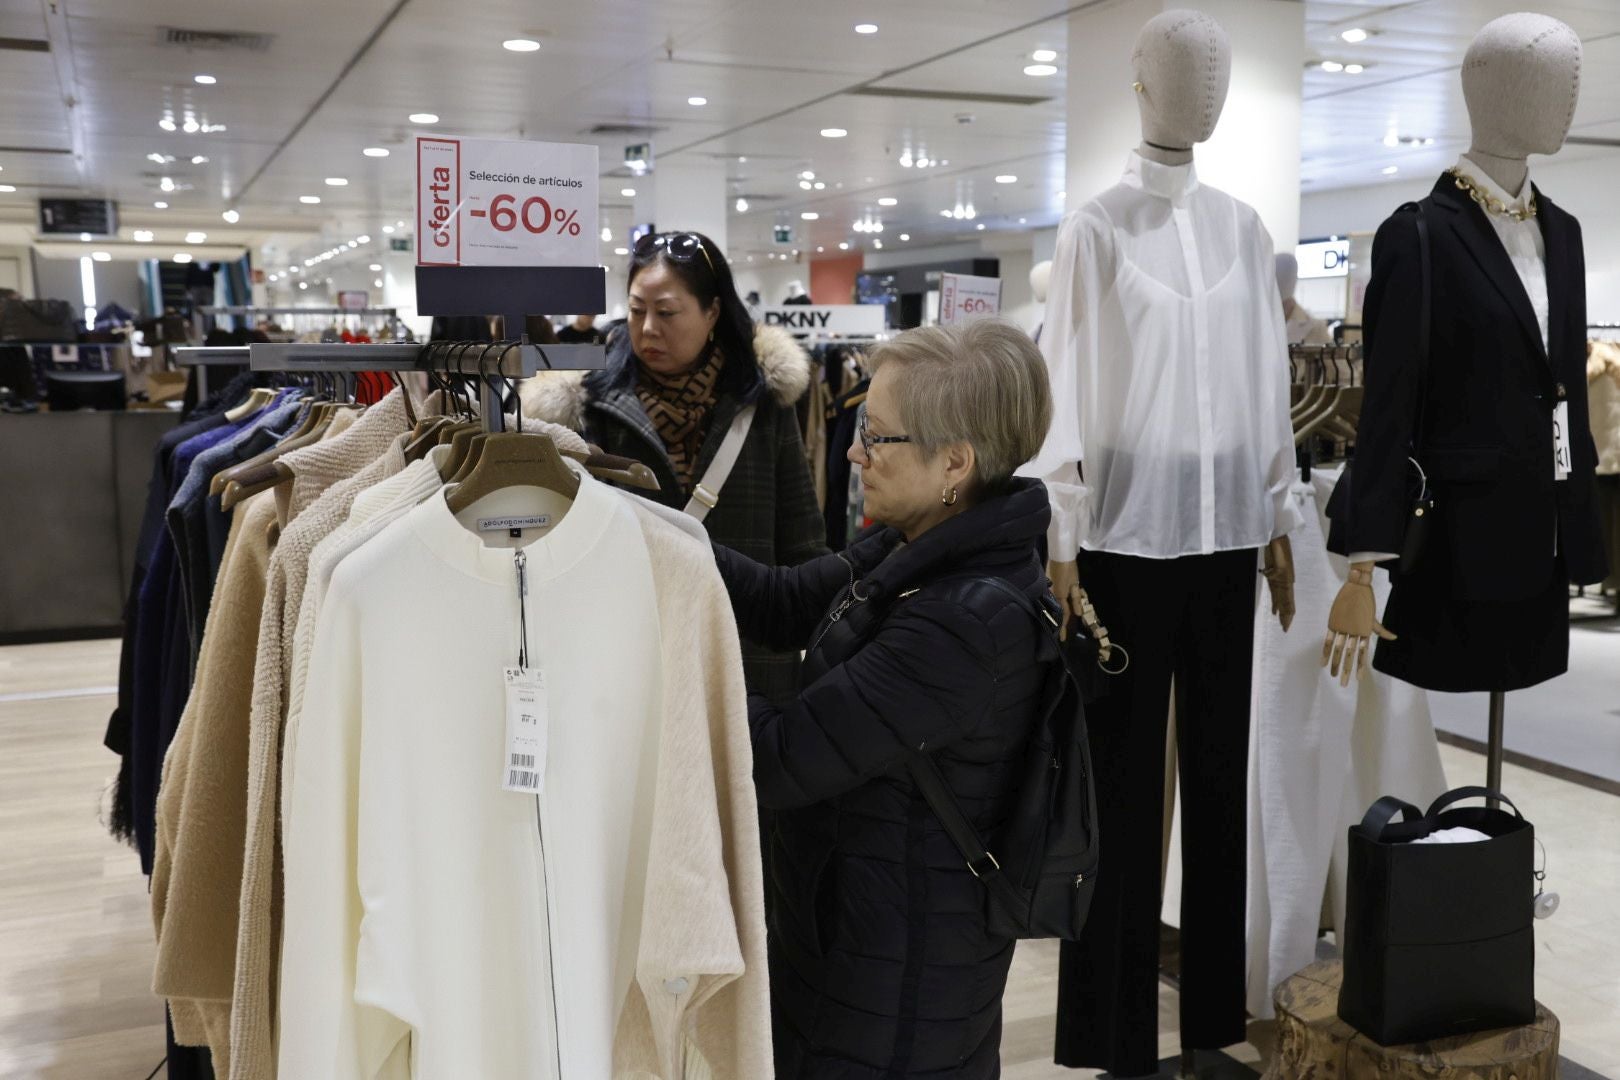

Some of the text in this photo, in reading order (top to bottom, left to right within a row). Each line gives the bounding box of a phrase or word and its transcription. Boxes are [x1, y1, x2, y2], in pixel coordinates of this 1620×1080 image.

[469, 170, 583, 188] Selección de artículos
[428, 166, 451, 248] oferta
[470, 193, 581, 237] -60%
[943, 287, 953, 319] oferta
[765, 311, 831, 328] DKNY
